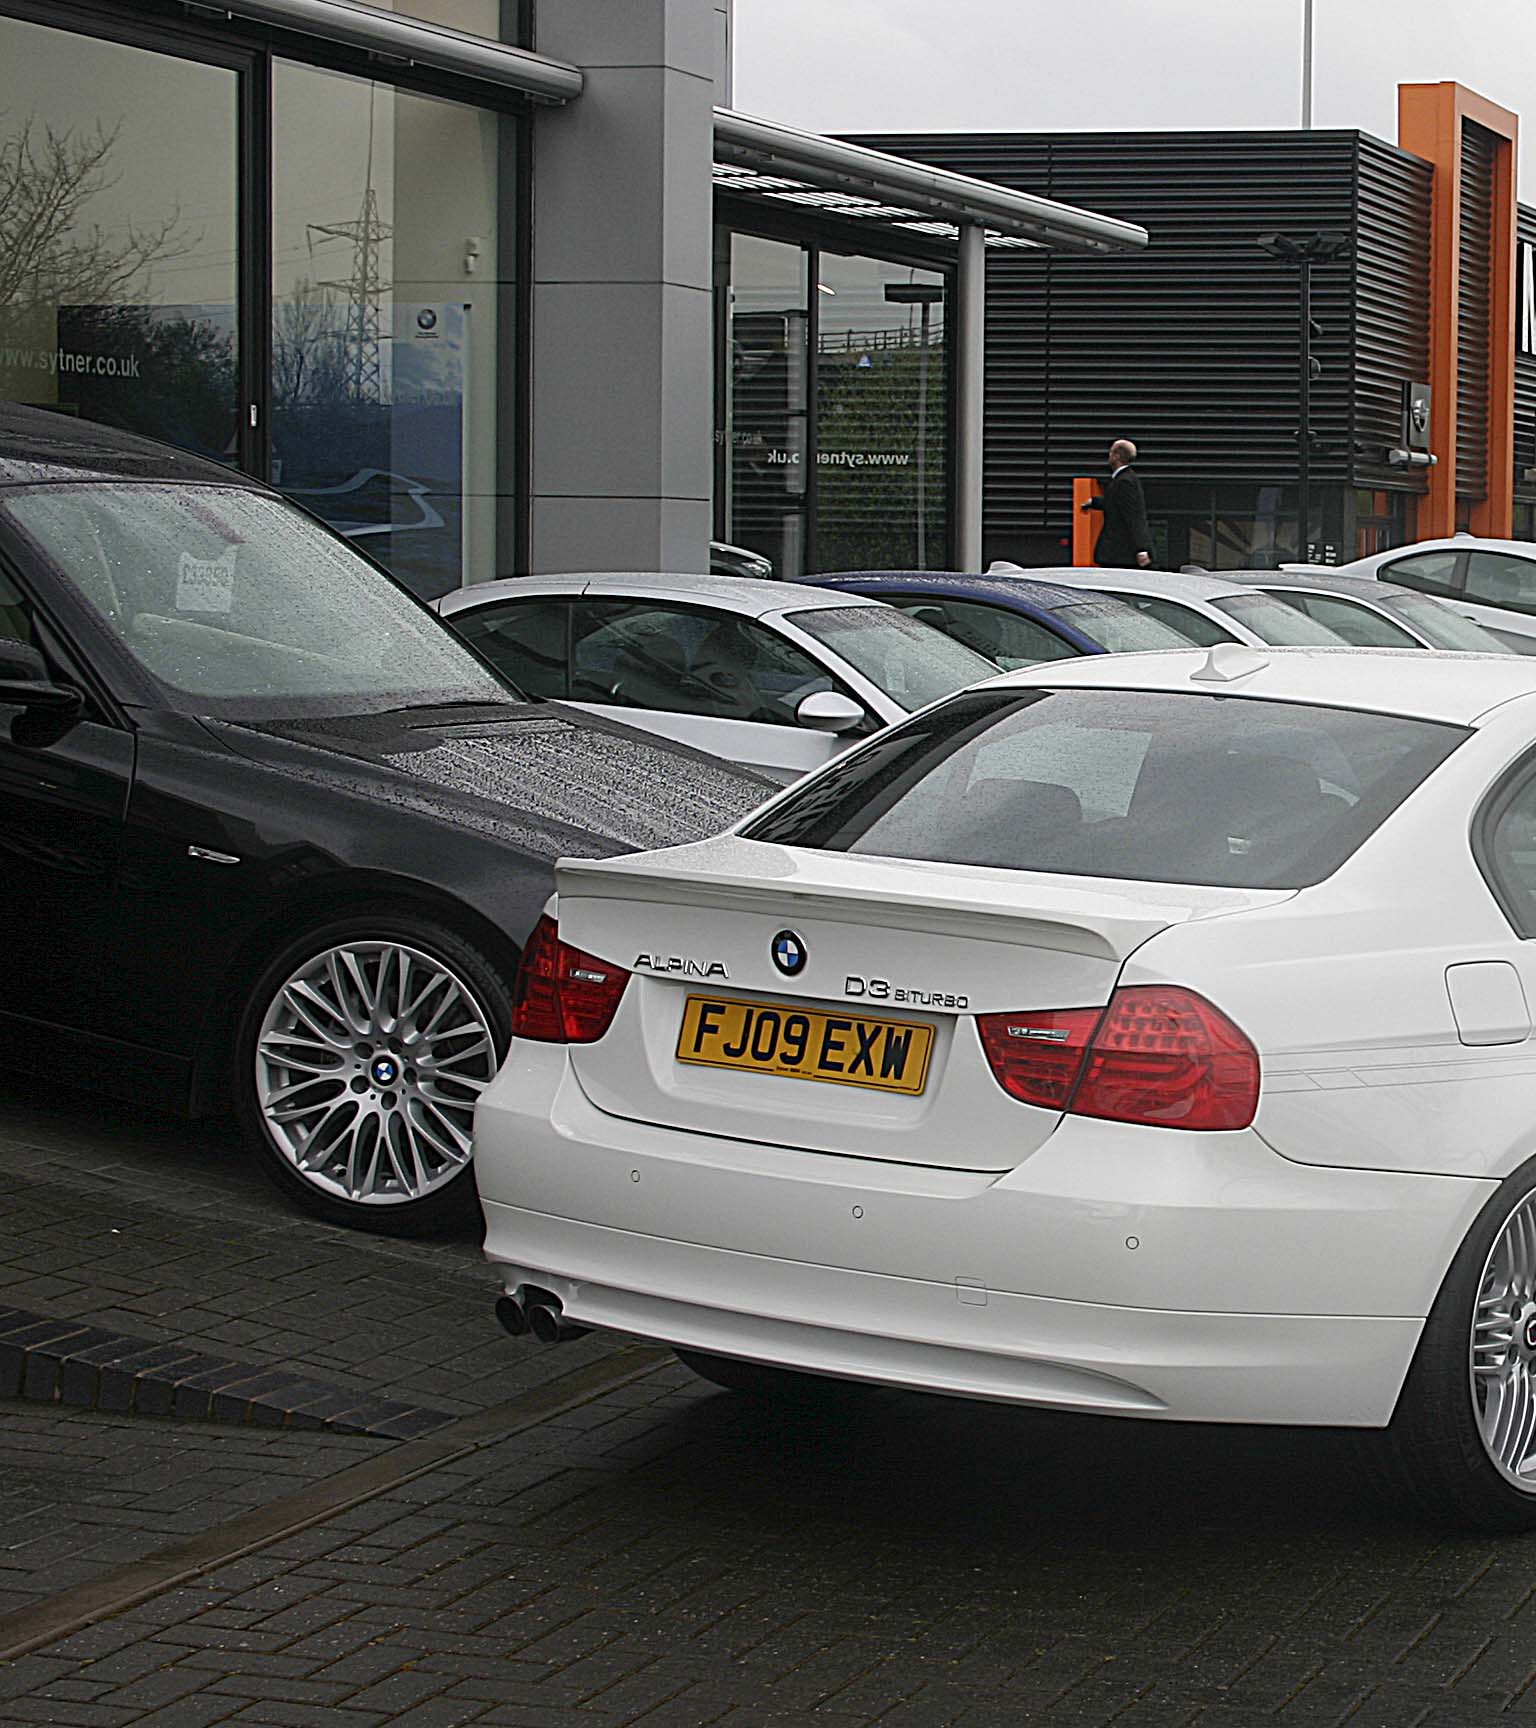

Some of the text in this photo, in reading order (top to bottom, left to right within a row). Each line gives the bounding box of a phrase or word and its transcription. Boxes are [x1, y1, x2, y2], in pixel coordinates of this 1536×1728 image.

[633, 954, 730, 979] ALPINA
[844, 976, 969, 1010] D3 BITURBO
[692, 1004, 913, 1081] FJ09 EXW
